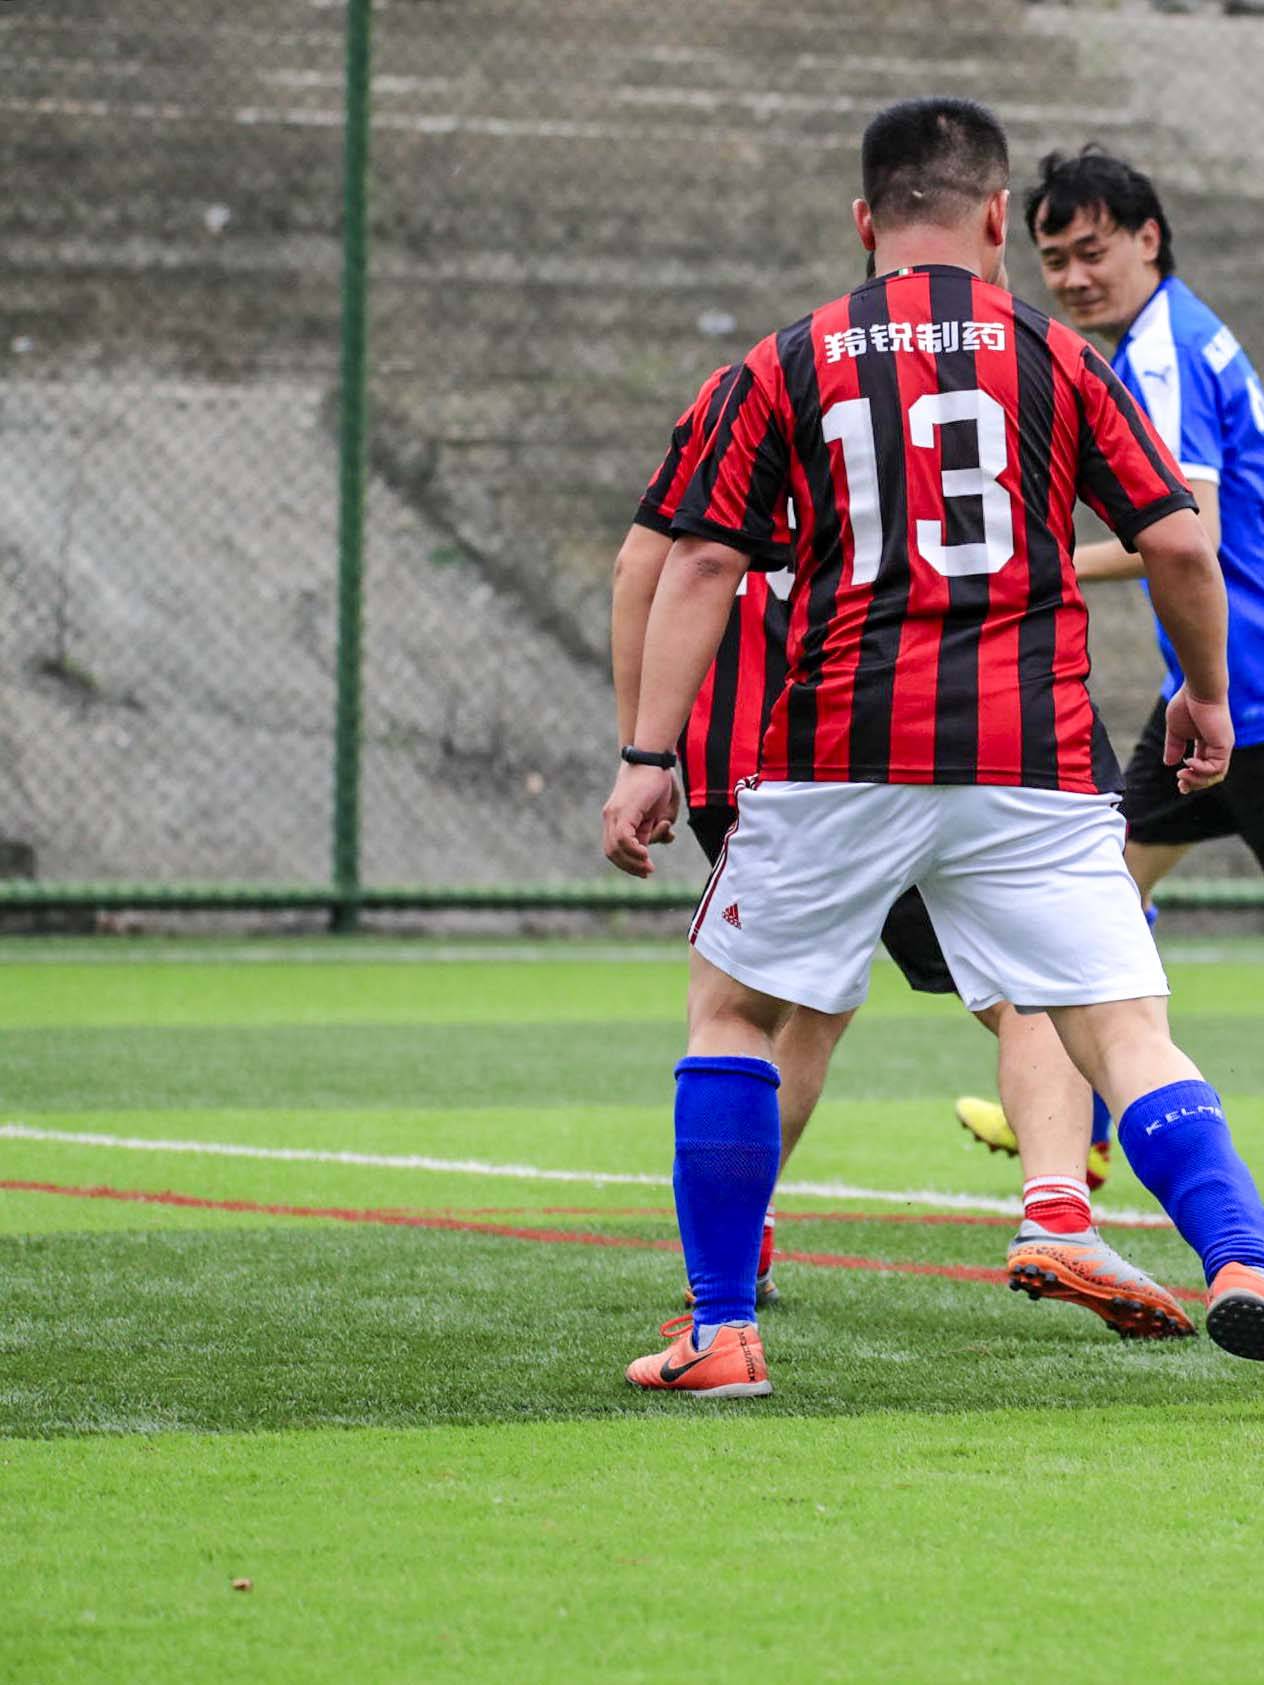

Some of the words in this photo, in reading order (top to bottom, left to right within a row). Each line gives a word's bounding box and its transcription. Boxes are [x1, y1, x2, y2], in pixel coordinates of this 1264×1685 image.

[823, 321, 1006, 363] 羚锐制药
[821, 388, 1014, 586] 13
